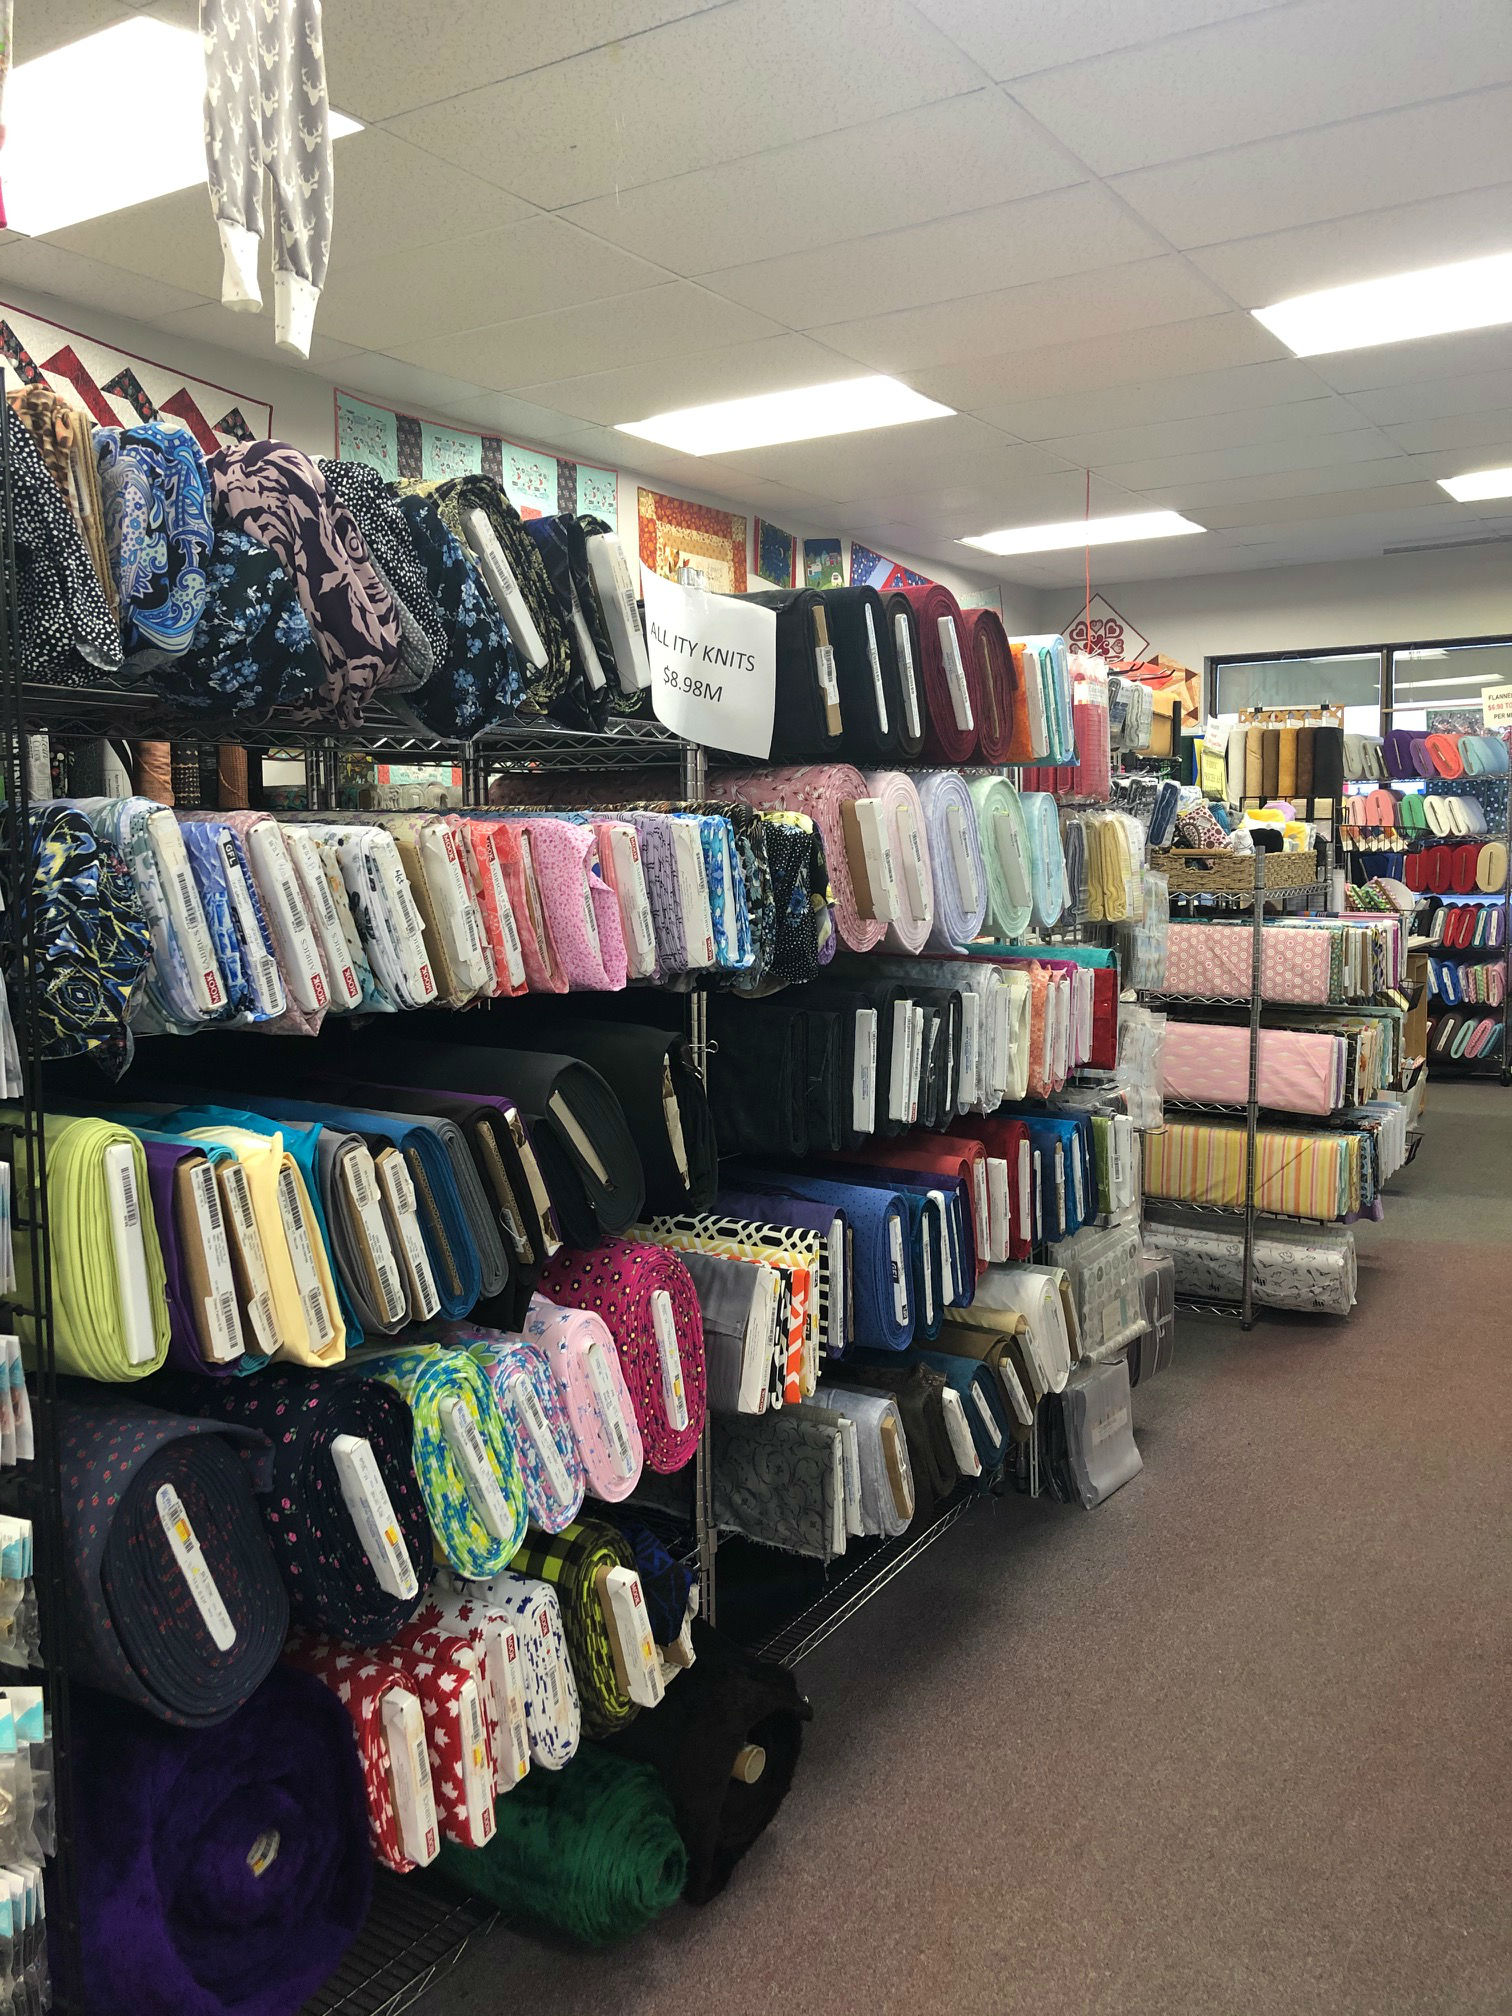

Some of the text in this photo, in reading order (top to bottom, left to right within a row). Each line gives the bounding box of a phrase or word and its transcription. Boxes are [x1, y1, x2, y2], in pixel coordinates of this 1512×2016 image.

[650, 621, 755, 672] ALL ITY KNITS
[663, 665, 723, 702] $8.98M
[223, 842, 239, 868] GFL
[443, 833, 456, 862] MOOK
[411, 932, 433, 995] MOOK FABRIC
[206, 971, 221, 1004] MOOK
[312, 974, 326, 1006] MOOK
[343, 967, 358, 998] MOOK
[539, 1610, 549, 1637] MOOK
[506, 1633, 516, 1662] MOOK
[426, 1828, 435, 1858] MOOK
